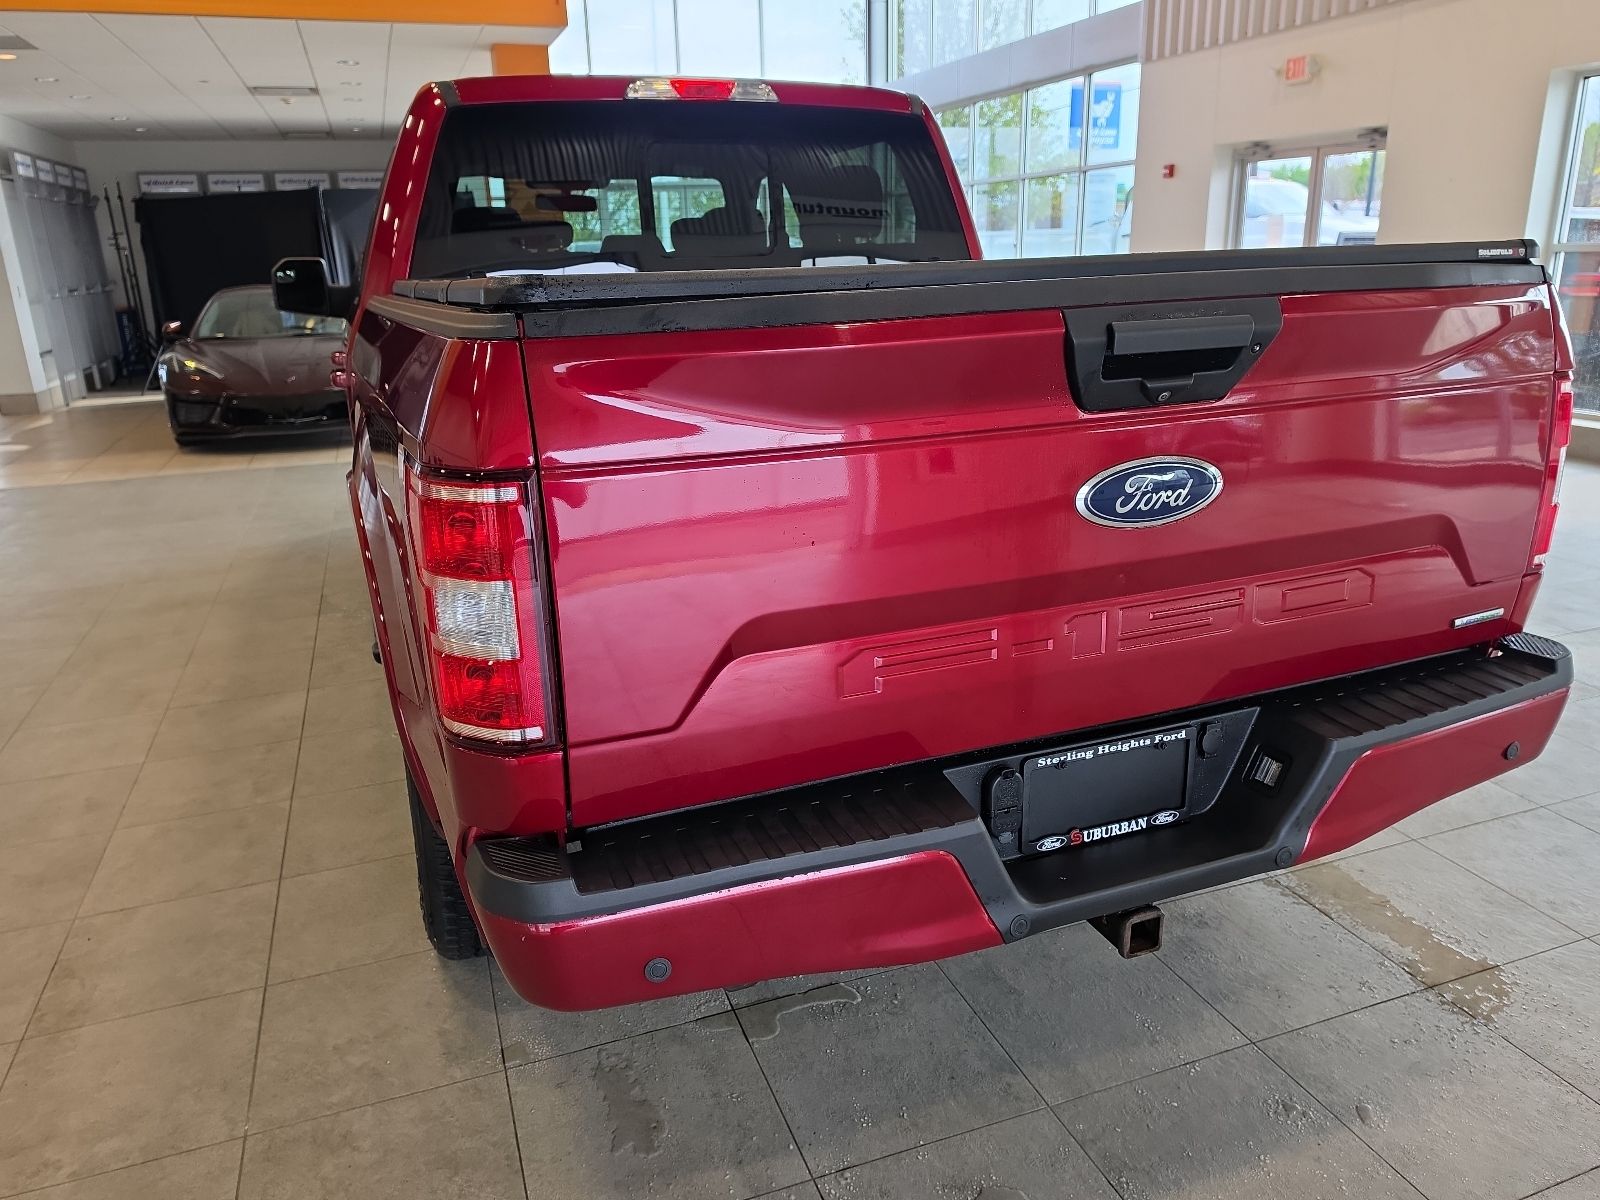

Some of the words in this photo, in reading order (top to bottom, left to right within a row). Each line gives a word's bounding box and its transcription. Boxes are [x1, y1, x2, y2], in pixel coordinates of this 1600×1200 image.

[1115, 472, 1194, 514] Ford
[837, 567, 1374, 699] F-150
[1037, 750, 1095, 768] Sterling
[1097, 739, 1151, 755] Heights
[1154, 730, 1187, 744] Ford
[1070, 816, 1148, 846] SUBURBAN
